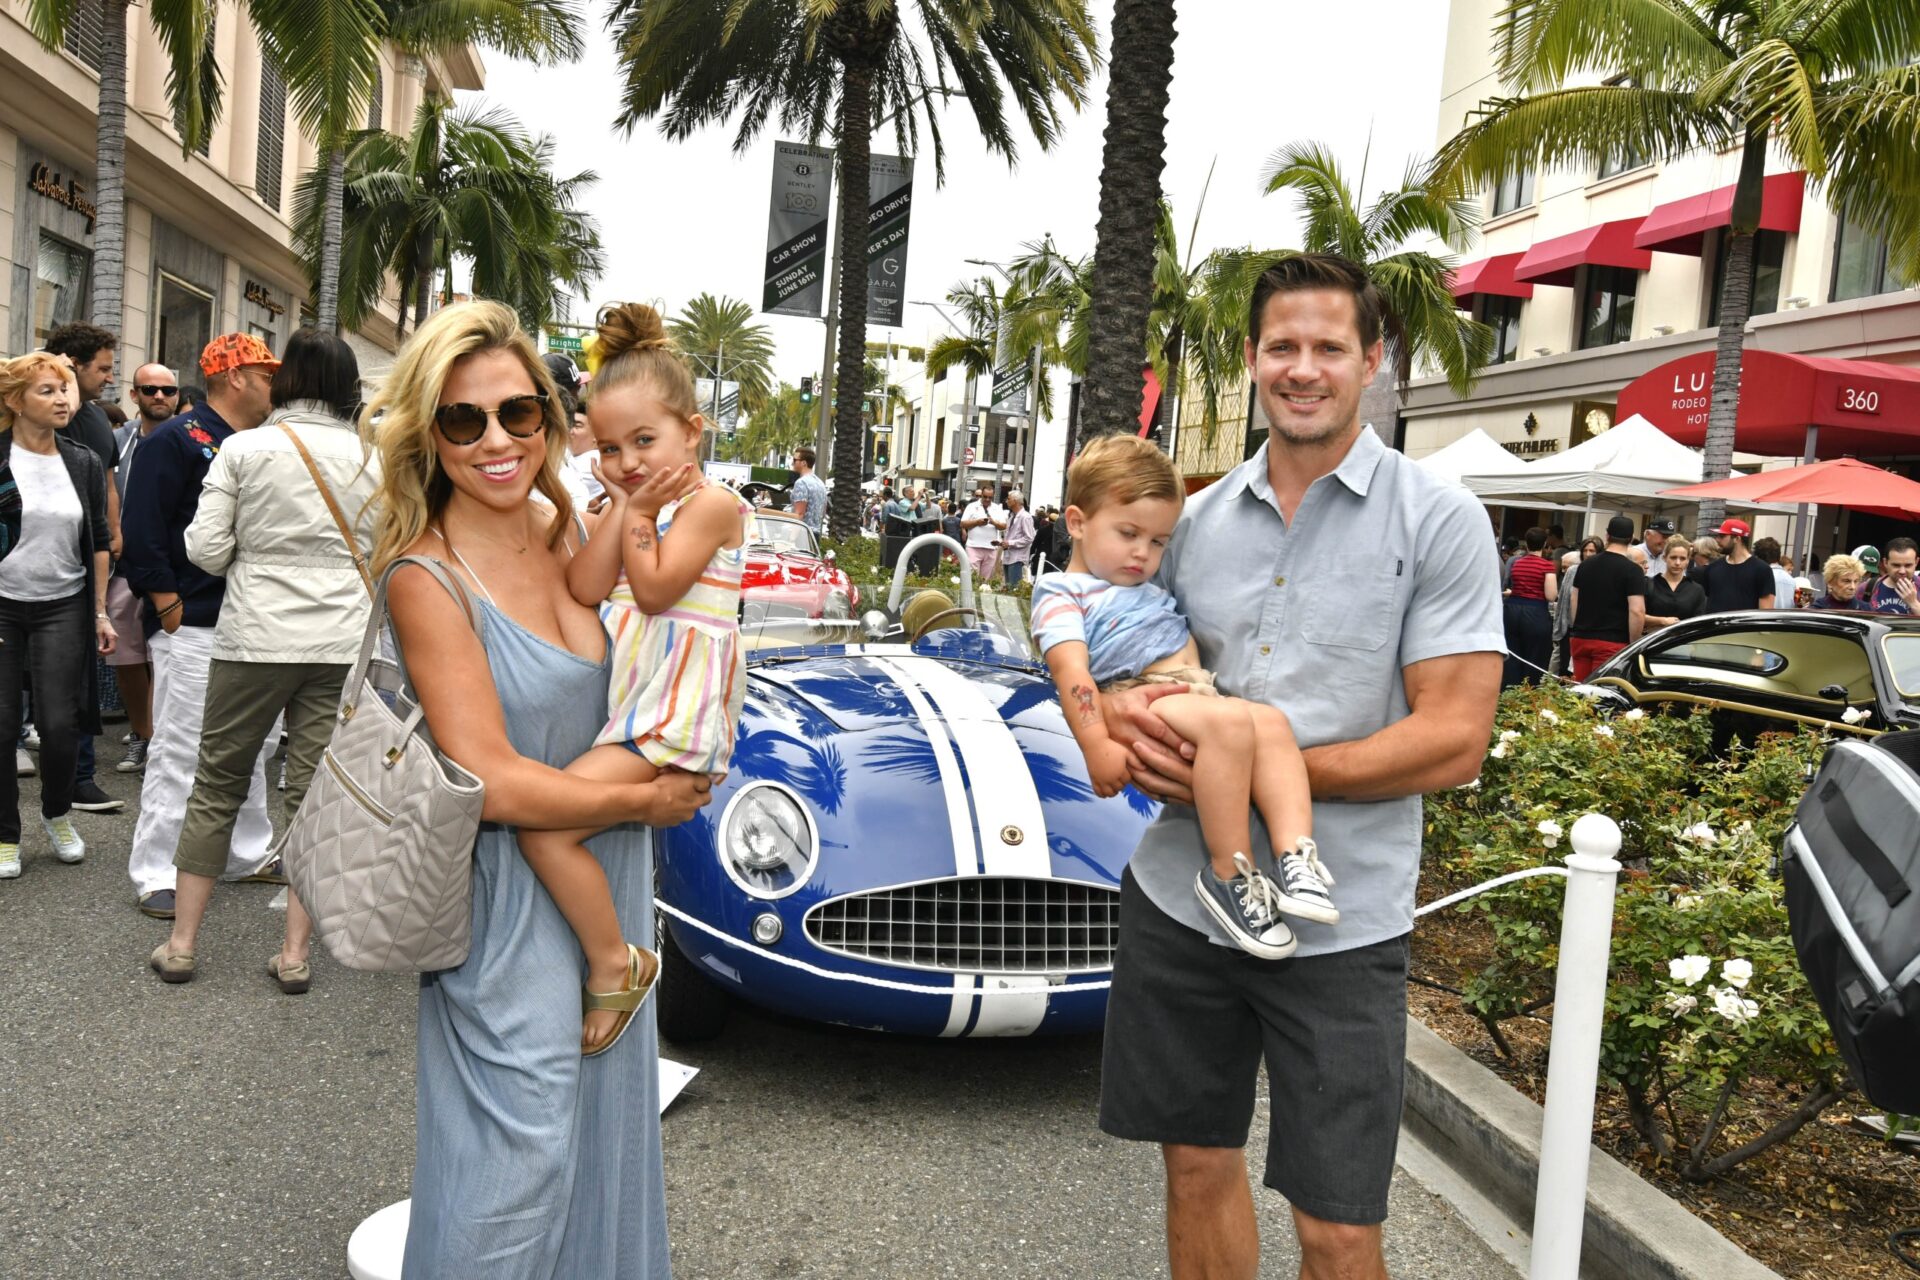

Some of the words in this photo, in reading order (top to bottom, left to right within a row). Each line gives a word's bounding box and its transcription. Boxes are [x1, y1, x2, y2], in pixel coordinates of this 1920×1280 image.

[779, 147, 830, 160] CELEBRATING
[787, 181, 815, 189] BENTLEY
[785, 192, 817, 211] 100
[867, 209, 884, 225] DEO
[883, 194, 910, 214] DRIVE
[888, 227, 906, 242] DAY
[772, 249, 791, 264] CAR
[790, 233, 817, 254] SHOW
[775, 264, 808, 288] SUNDAY
[778, 282, 799, 299] JUNE
[797, 271, 817, 286] 16TH
[550, 339, 581, 348] Brighto
[1015, 373, 1026, 382] DAY
[1671, 397, 1707, 410] RODEO
[1843, 388, 1879, 411] 360
[1687, 413, 1708, 425] HOT
[1523, 438, 1559, 454] PHILIPPE
